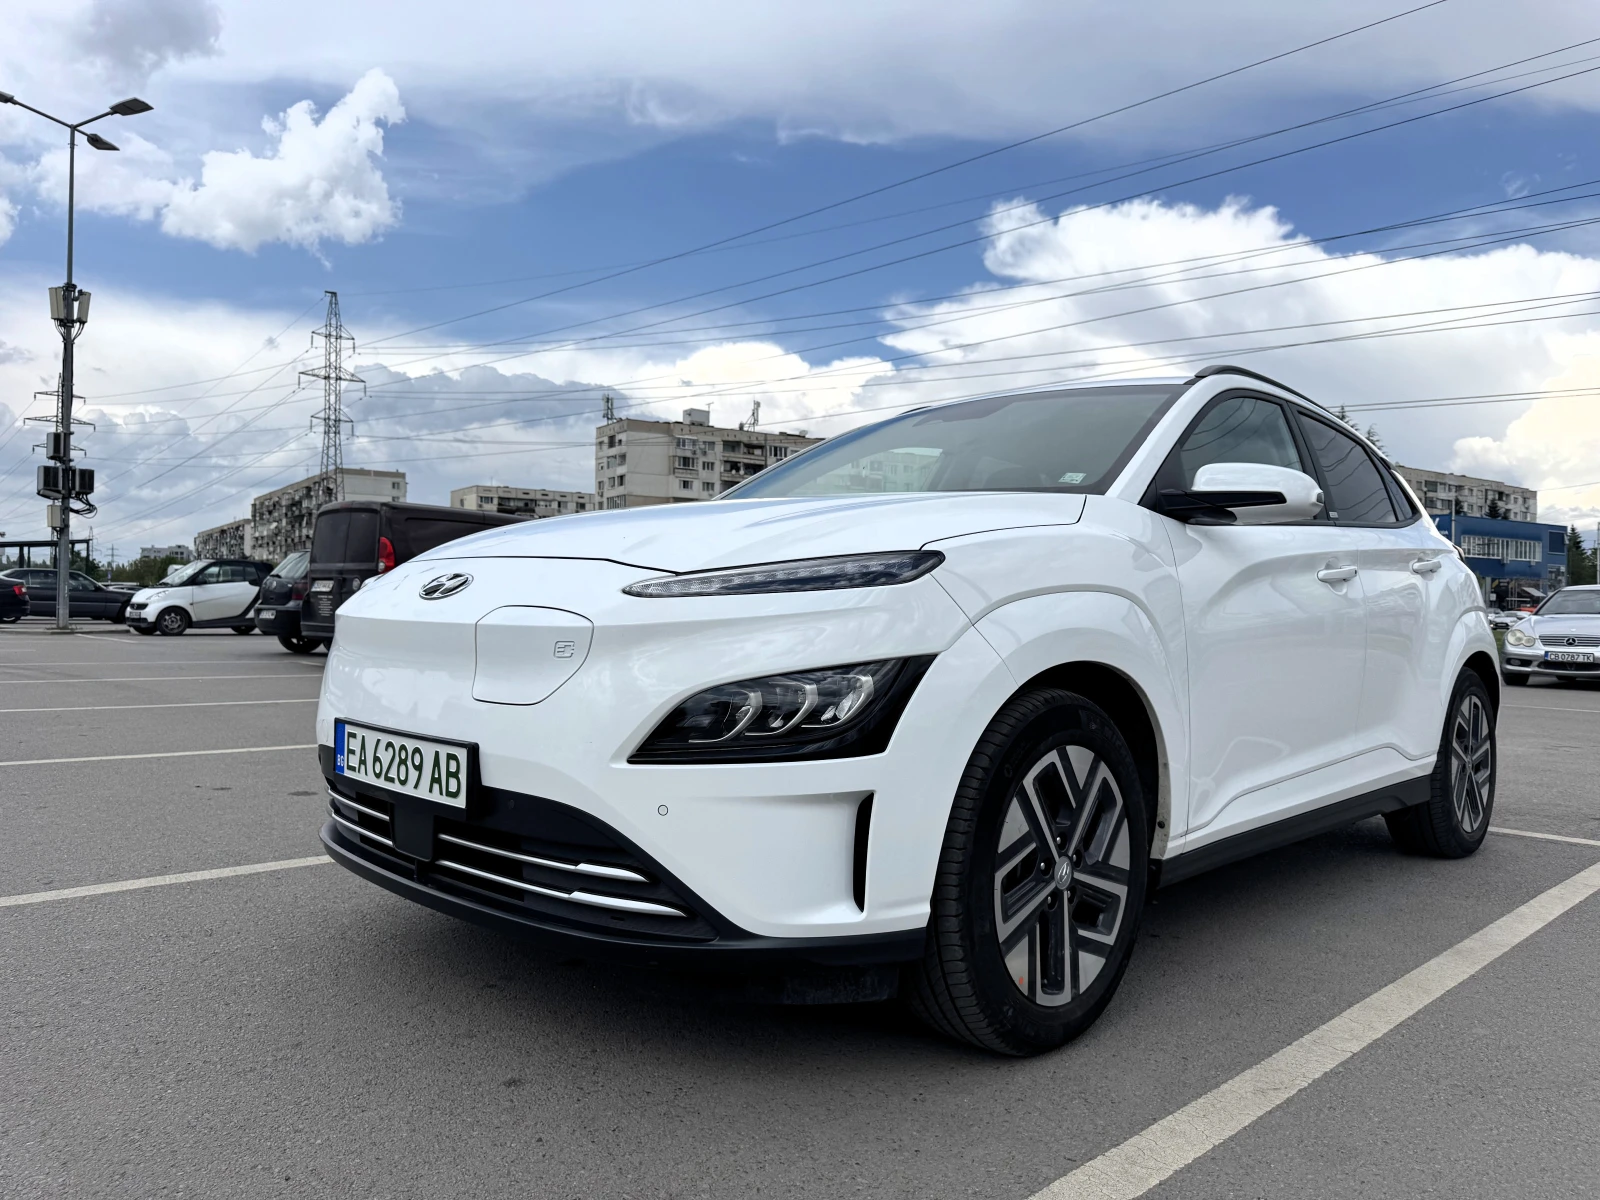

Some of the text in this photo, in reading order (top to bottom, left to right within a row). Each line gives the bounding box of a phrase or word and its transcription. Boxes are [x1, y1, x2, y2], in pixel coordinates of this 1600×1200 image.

[1549, 653, 1592, 662] CB 0787 TK
[337, 754, 345, 767] BG
[346, 731, 462, 799] EA 6289 AB
